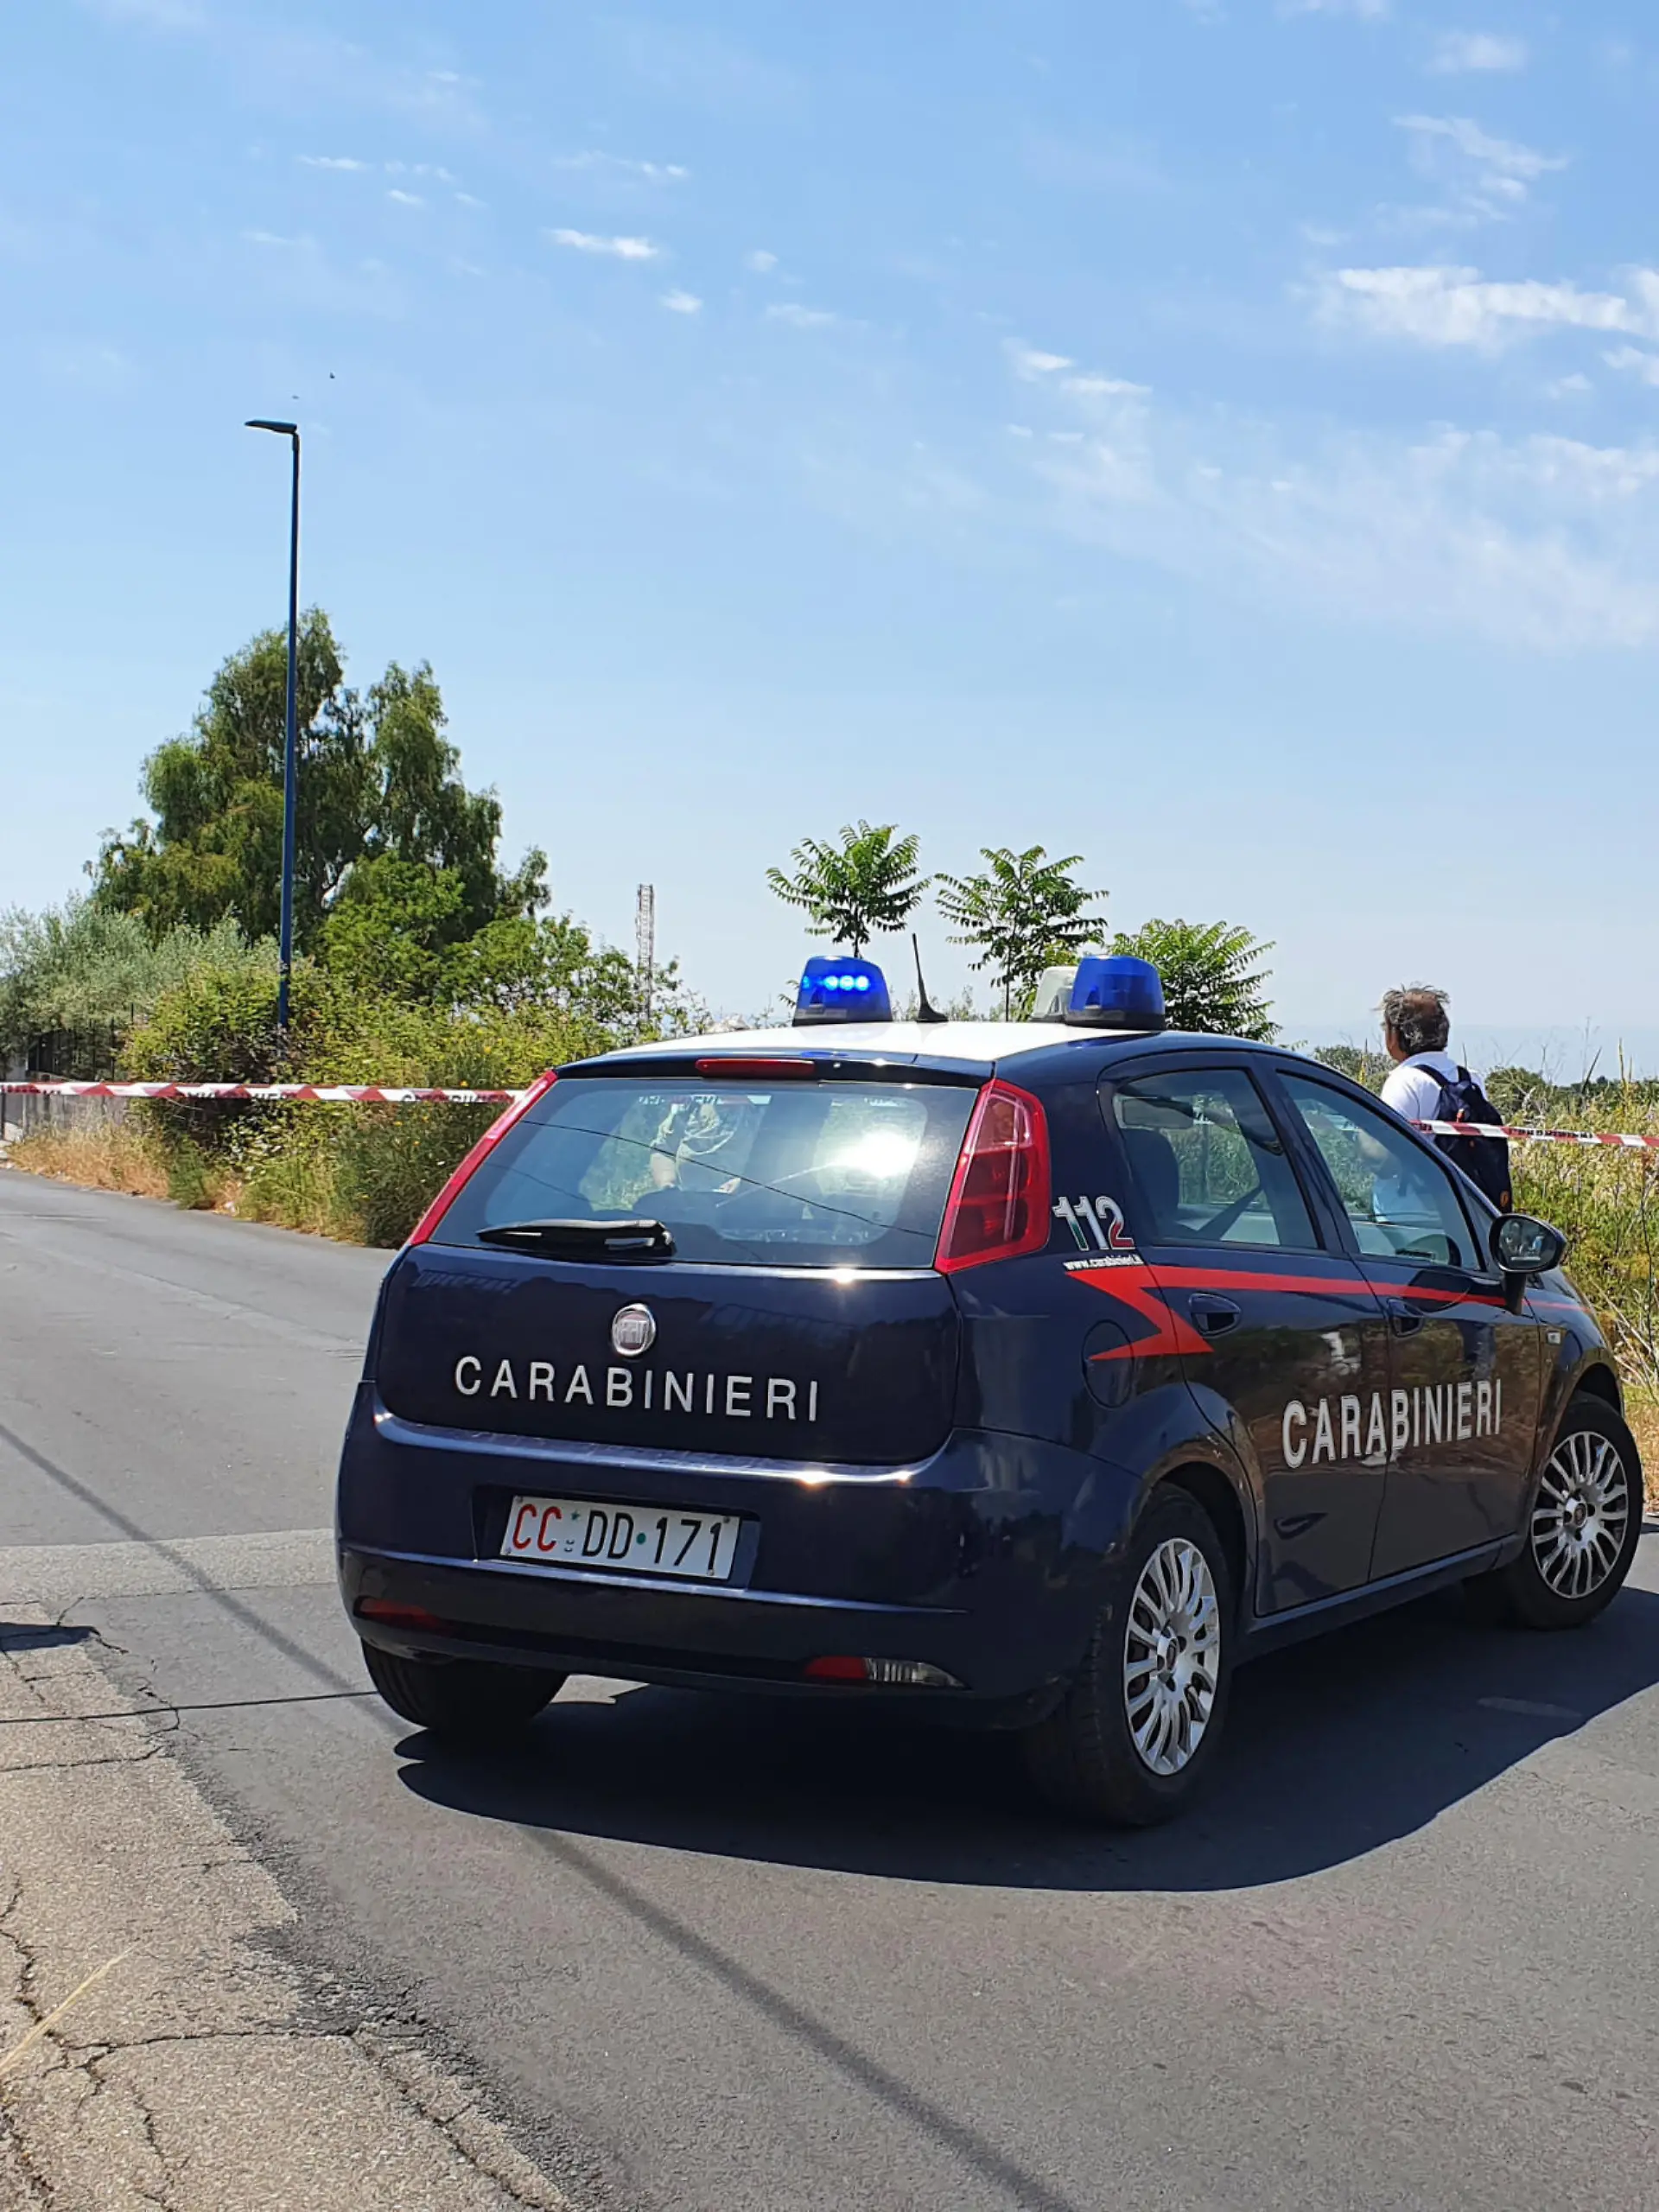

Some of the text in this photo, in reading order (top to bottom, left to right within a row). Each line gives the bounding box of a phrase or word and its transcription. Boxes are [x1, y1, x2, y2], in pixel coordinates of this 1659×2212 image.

[1052, 1196, 1135, 1251] 112
[454, 1356, 818, 1421] CARABINIERI
[1282, 1379, 1501, 1468] CARABINIERI
[512, 1503, 562, 1552] CC
